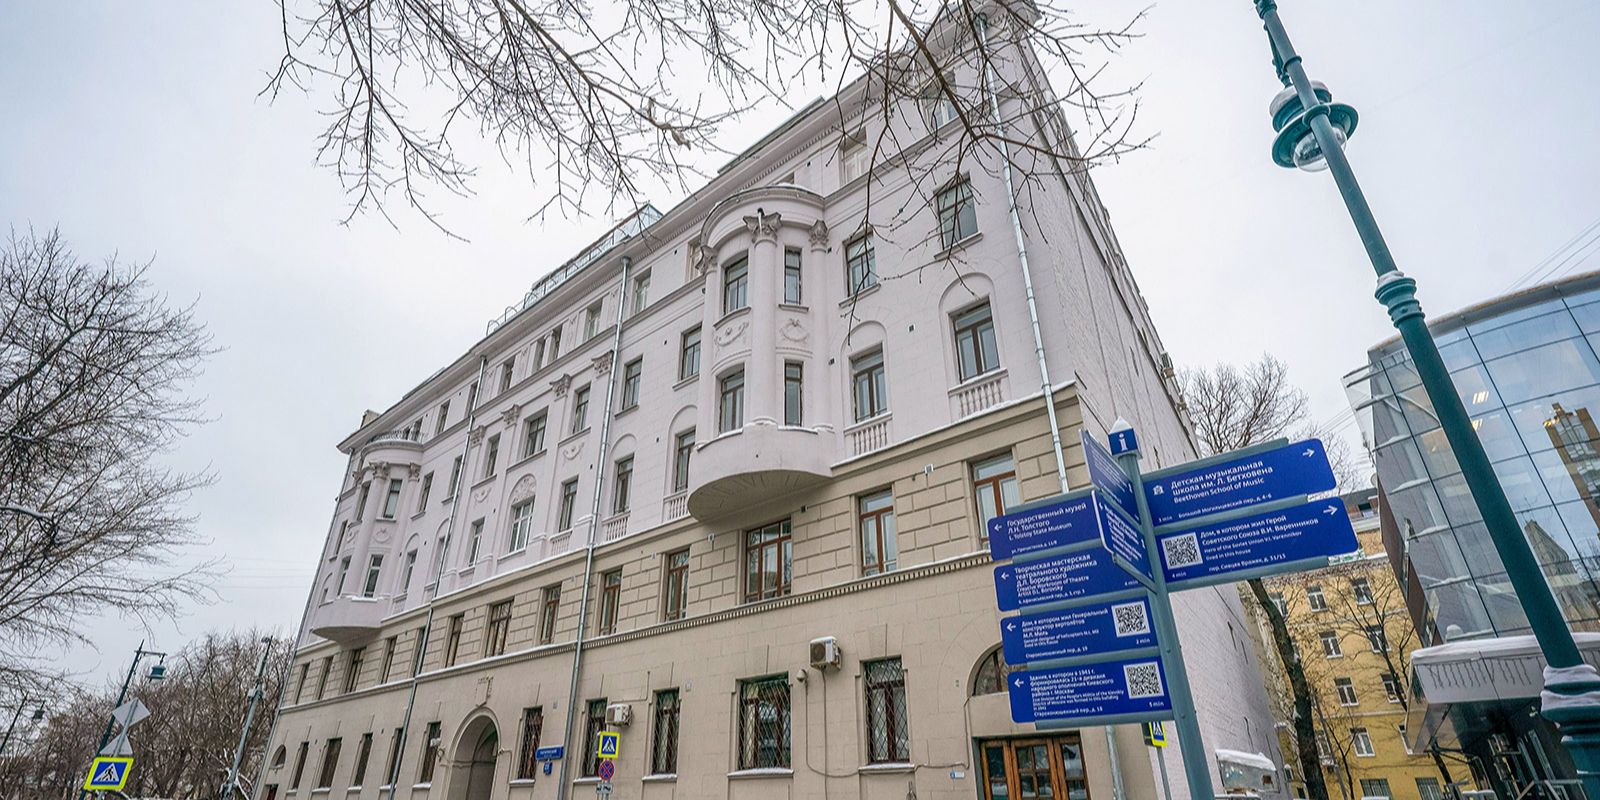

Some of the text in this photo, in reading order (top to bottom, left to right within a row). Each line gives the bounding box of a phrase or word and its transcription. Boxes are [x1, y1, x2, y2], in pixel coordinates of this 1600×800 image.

[1171, 460, 1263, 489] Детская музыкальная
[1172, 484, 1200, 496] школа
[1201, 481, 1216, 489] им.
[1227, 466, 1273, 483] Бетховена
[1174, 489, 1210, 504] Beethoven
[1210, 484, 1233, 496] School
[1243, 478, 1264, 487] Music
[1007, 502, 1086, 527] Государственный музей
[1178, 509, 1201, 518] Большой
[1021, 520, 1050, 531] Толстого
[1048, 523, 1072, 532] Museum
[1202, 533, 1238, 546] Советского
[1238, 530, 1260, 539] Союза
[1275, 518, 1319, 532] Варенников
[1222, 524, 1250, 534] котором
[1266, 514, 1286, 525] Герой
[1273, 530, 1302, 540] Varennikov
[1015, 554, 1091, 574] Творческая мастерская
[1016, 560, 1097, 580] театрального художника
[1030, 573, 1067, 585] Боровского
[1072, 608, 1108, 619] Генеральный
